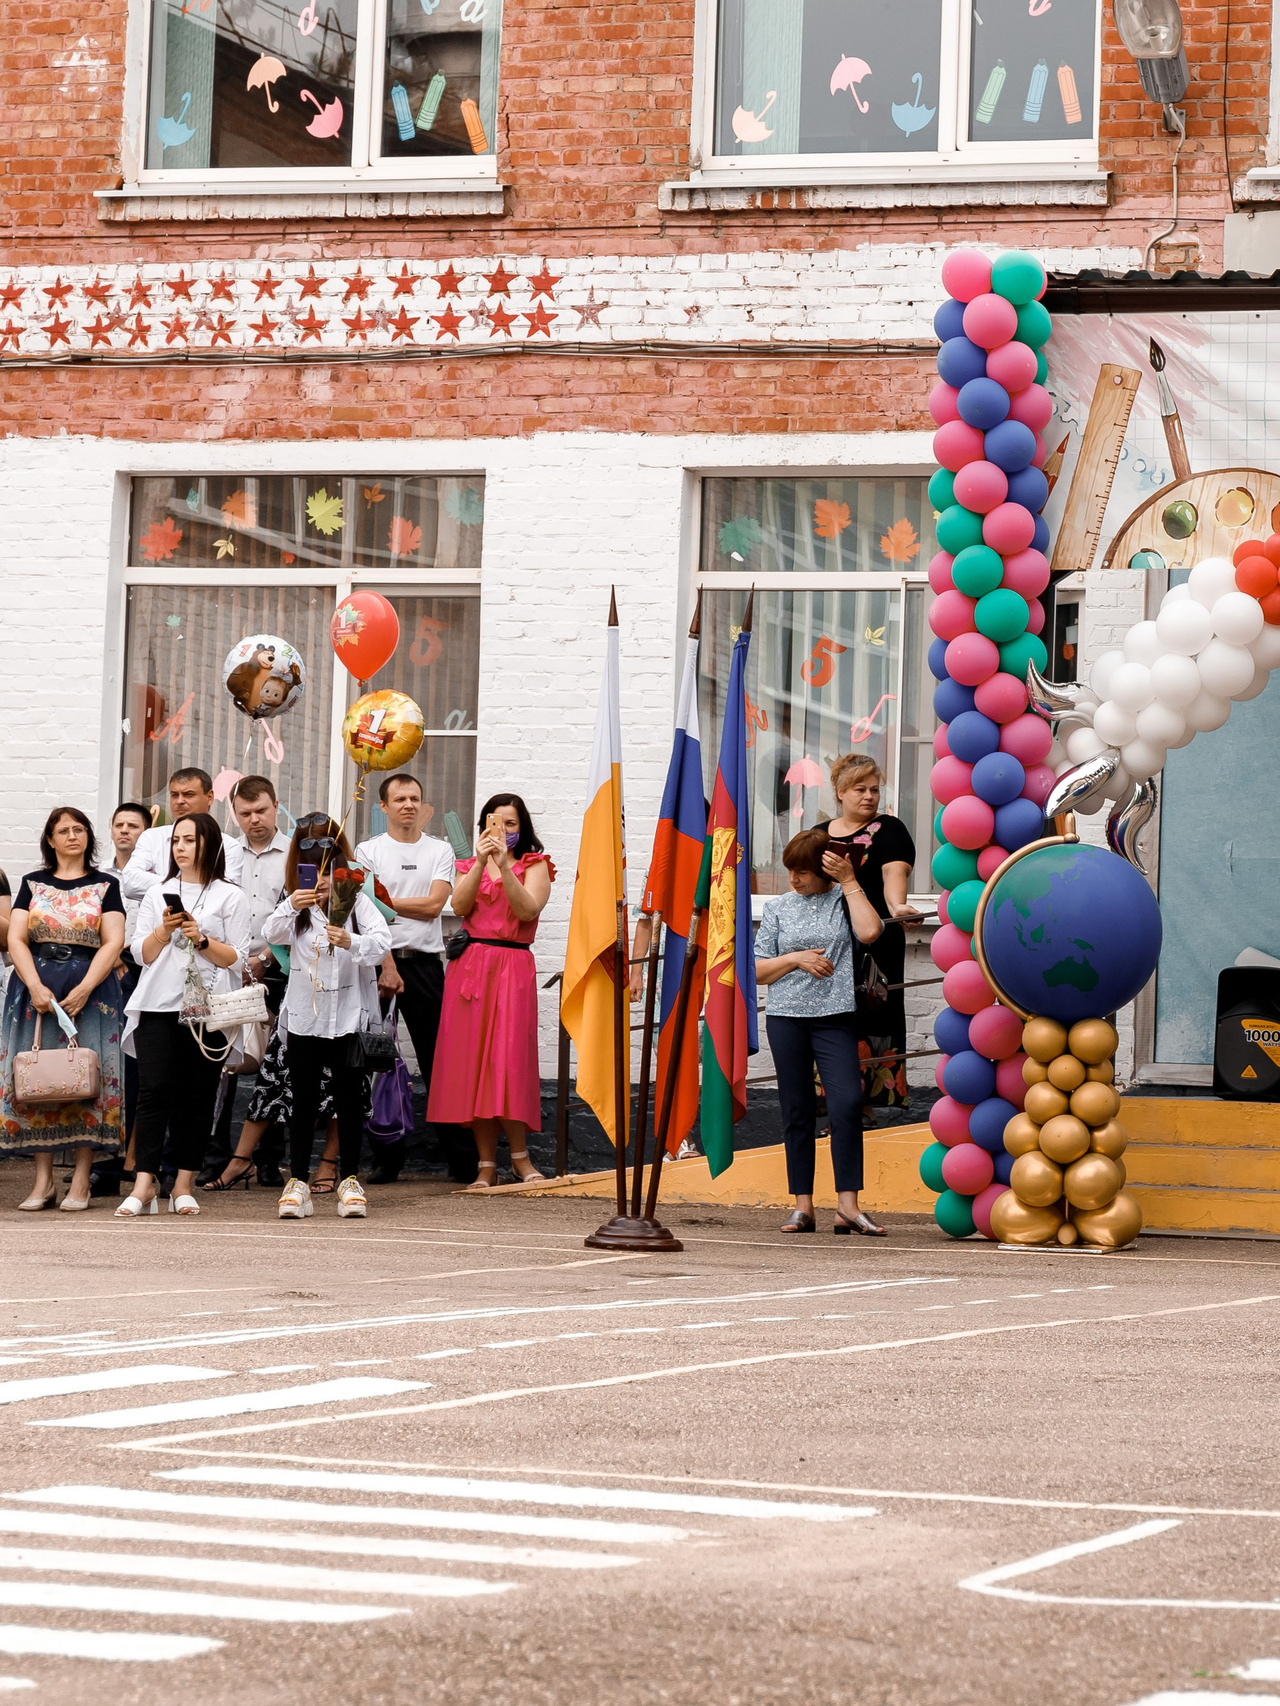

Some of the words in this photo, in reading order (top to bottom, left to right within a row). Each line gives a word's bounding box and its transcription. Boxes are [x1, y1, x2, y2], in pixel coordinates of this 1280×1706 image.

[338, 610, 347, 629] 1
[239, 644, 251, 657] 1
[281, 644, 293, 659] 2
[409, 614, 449, 667] 5
[801, 634, 848, 688] 5
[370, 708, 387, 734] 1
